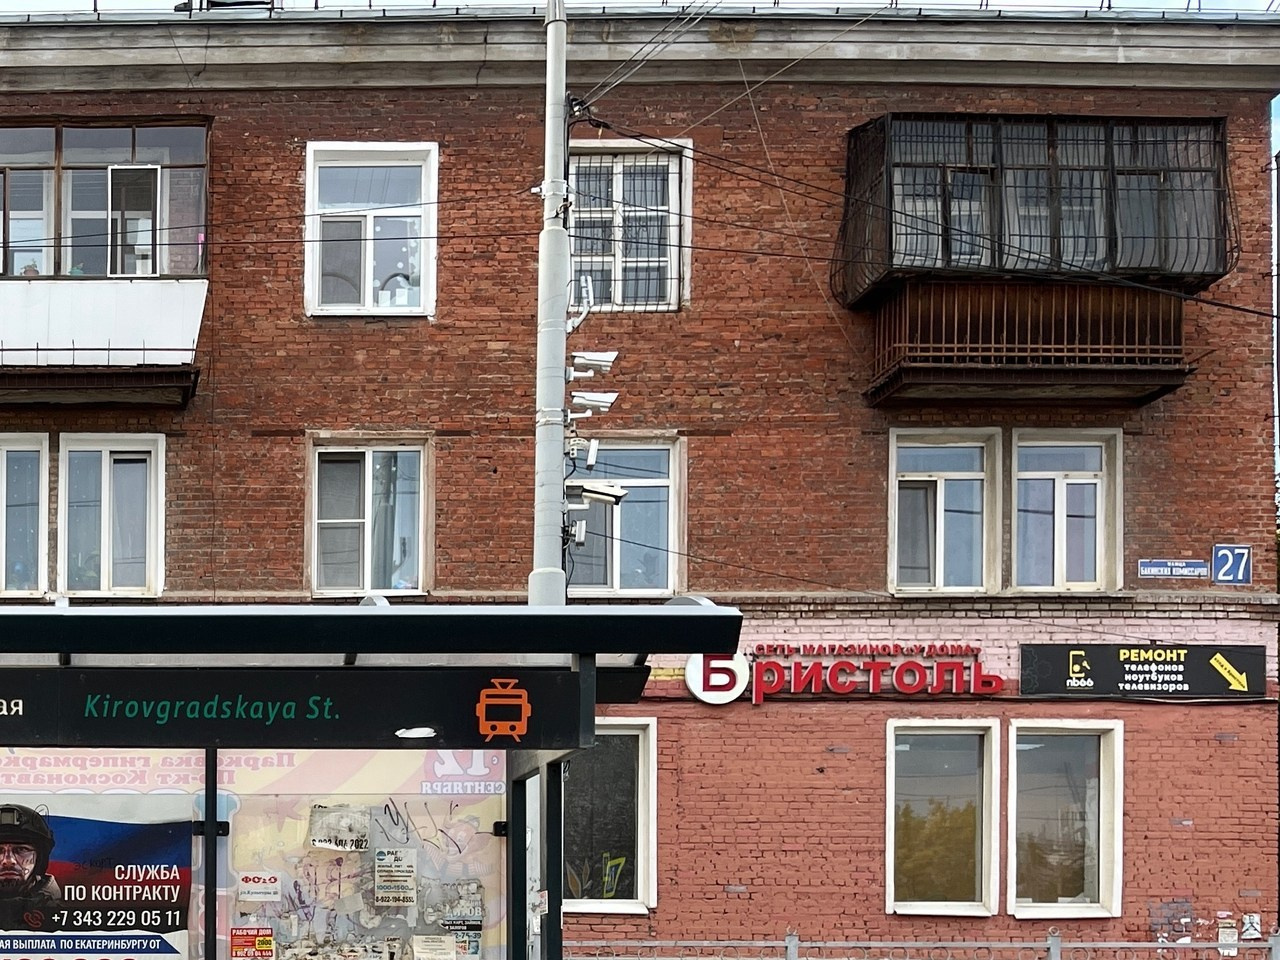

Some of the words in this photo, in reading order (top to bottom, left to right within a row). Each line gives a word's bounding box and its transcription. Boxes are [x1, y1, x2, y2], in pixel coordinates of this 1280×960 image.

[1217, 549, 1249, 580] 27
[756, 644, 796, 656] СЕТЬ
[801, 644, 903, 656] МАГАЗИНОВ
[1119, 649, 1188, 662] РЕМОНТ
[1124, 663, 1185, 675] телефонов
[702, 653, 1005, 705] Бристоль
[1066, 677, 1095, 687] nb66
[1124, 673, 1184, 683] ноутбуков
[1118, 682, 1190, 692] телевизоров
[84, 693, 297, 726] Kirovgradskaya
[306, 694, 342, 721] St.
[114, 864, 180, 881] СЛУЖБА
[64, 885, 87, 901] ПО
[91, 885, 181, 903] КОНТРАКТУ
[51, 911, 69, 926] +7
[73, 910, 102, 926] 343
[107, 910, 136, 926] 229
[141, 910, 161, 926] 05
[165, 910, 180, 926] 11
[13, 939, 56, 950] ВЫПЛАТА
[60, 940, 74, 950] ПО
[75, 939, 149, 950] ЕКАТЕРИНБУРГУ
[149, 940, 161, 950] ОТ
